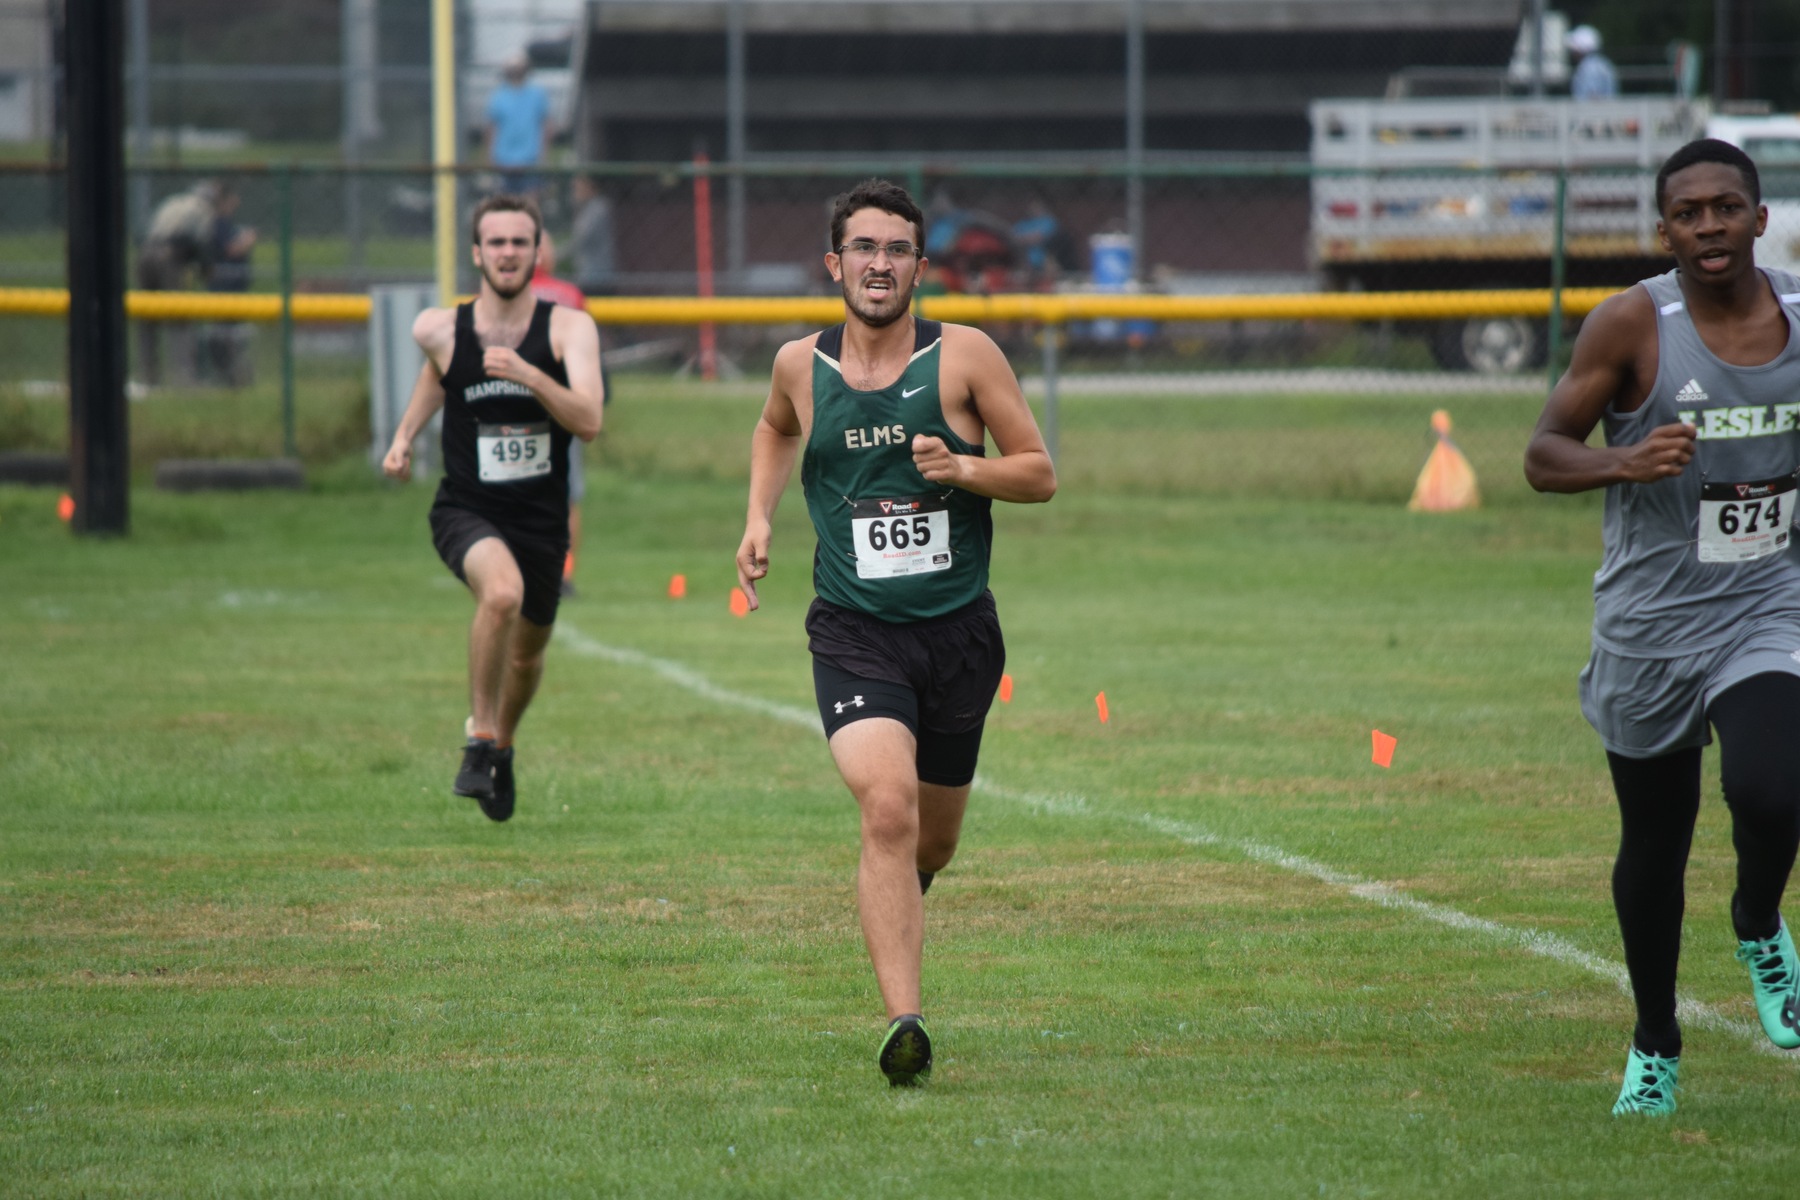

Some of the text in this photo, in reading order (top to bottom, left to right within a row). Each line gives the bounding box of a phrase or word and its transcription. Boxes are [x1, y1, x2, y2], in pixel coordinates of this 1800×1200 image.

[1675, 392, 1708, 402] adidas
[1678, 402, 1800, 440] LESLE
[492, 439, 538, 462] 495
[844, 424, 907, 449] ELMS
[1718, 496, 1780, 535] 674
[868, 516, 931, 551] 665
